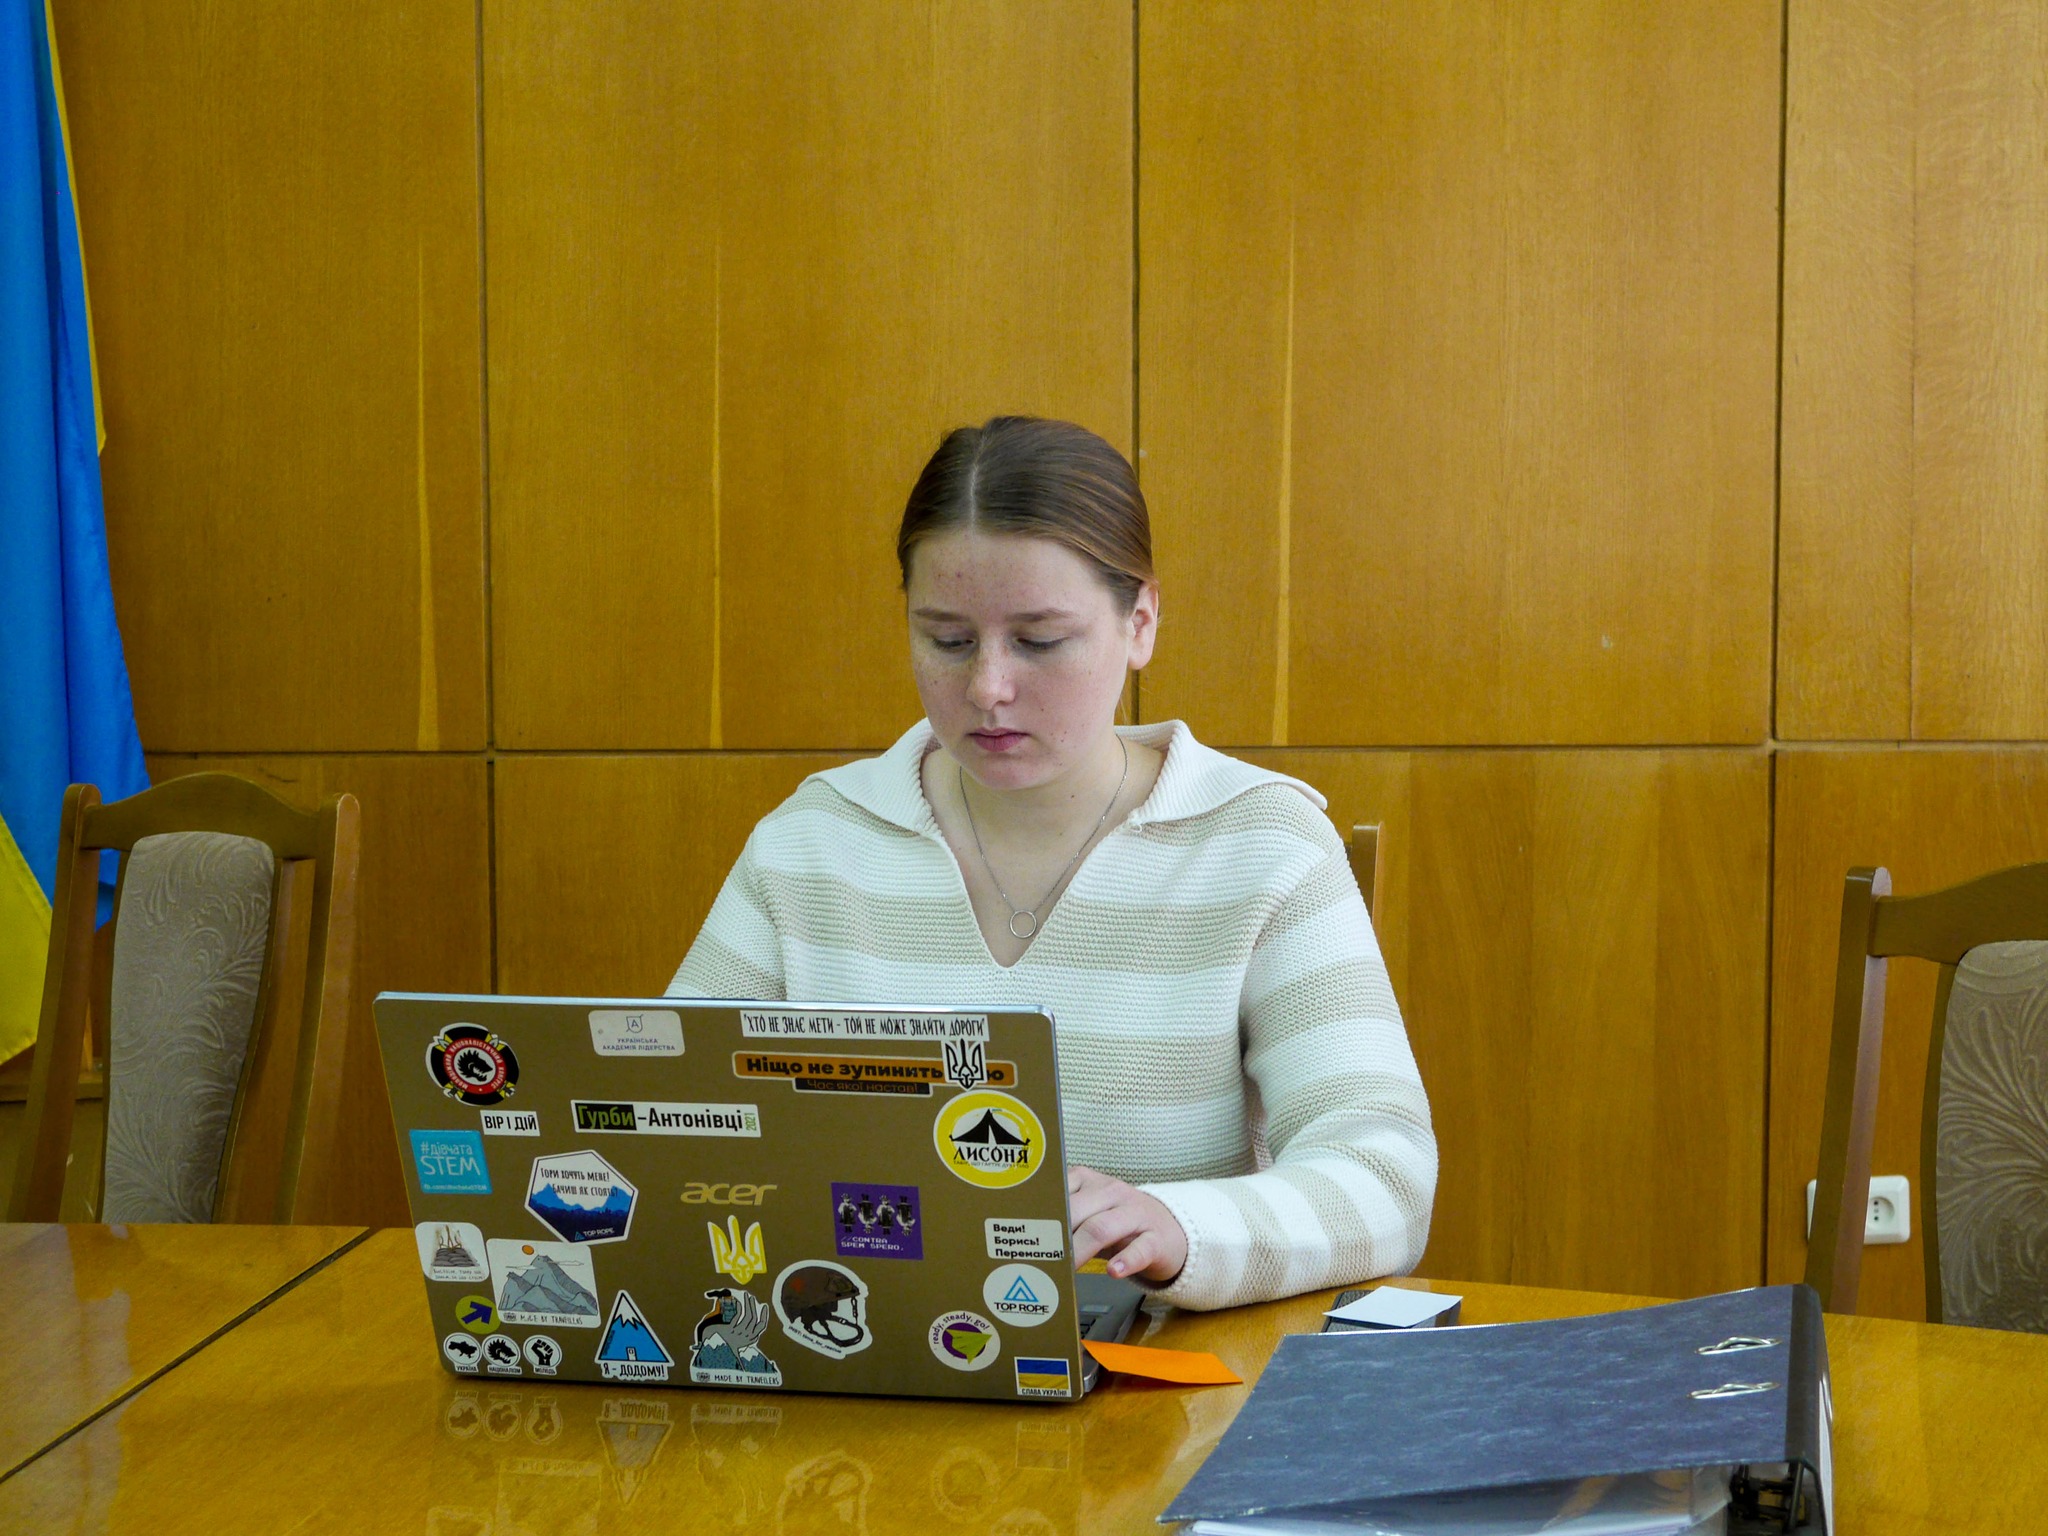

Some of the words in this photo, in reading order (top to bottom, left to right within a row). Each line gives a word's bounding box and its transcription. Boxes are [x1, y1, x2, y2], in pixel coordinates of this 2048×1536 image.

[768, 1016, 780, 1032] НЕ
[782, 1016, 806, 1034] ЗНАЄ
[809, 1018, 834, 1034] МЕТИ
[844, 1016, 863, 1034] ТОЙ
[865, 1018, 876, 1034] НЕ
[880, 1017, 907, 1036] МОЖЕ
[910, 1017, 946, 1036] ЗНАЙТИ
[746, 1056, 802, 1075] Ніщо
[808, 1062, 834, 1074] не
[838, 1063, 943, 1080] зупинить
[808, 1080, 834, 1090] Час
[836, 1081, 863, 1091] якої
[484, 1115, 504, 1129] ВІР
[514, 1114, 536, 1131] ДІЙ
[420, 1142, 473, 1156] #дівчата
[954, 1146, 1028, 1164] ЛИСОНЯ
[420, 1156, 481, 1176] STEM
[561, 1170, 585, 1180] ХОЧУТЬ
[588, 1172, 610, 1182] МЕНЕ!
[552, 1184, 577, 1194] БАЧИШ
[580, 1186, 588, 1196] ЯК
[680, 1182, 778, 1206] acer
[993, 1224, 1026, 1234] Веди!
[994, 1236, 1040, 1246] Борись!
[995, 1248, 1064, 1259] Перемагай!
[994, 1302, 1016, 1311] TOP
[1018, 1304, 1050, 1314] ROPE
[604, 1362, 610, 1375] Я
[620, 1364, 664, 1377] ДОДОМУ!
[714, 1374, 732, 1382] MADE
[748, 1376, 780, 1385] TRAVELLERS
